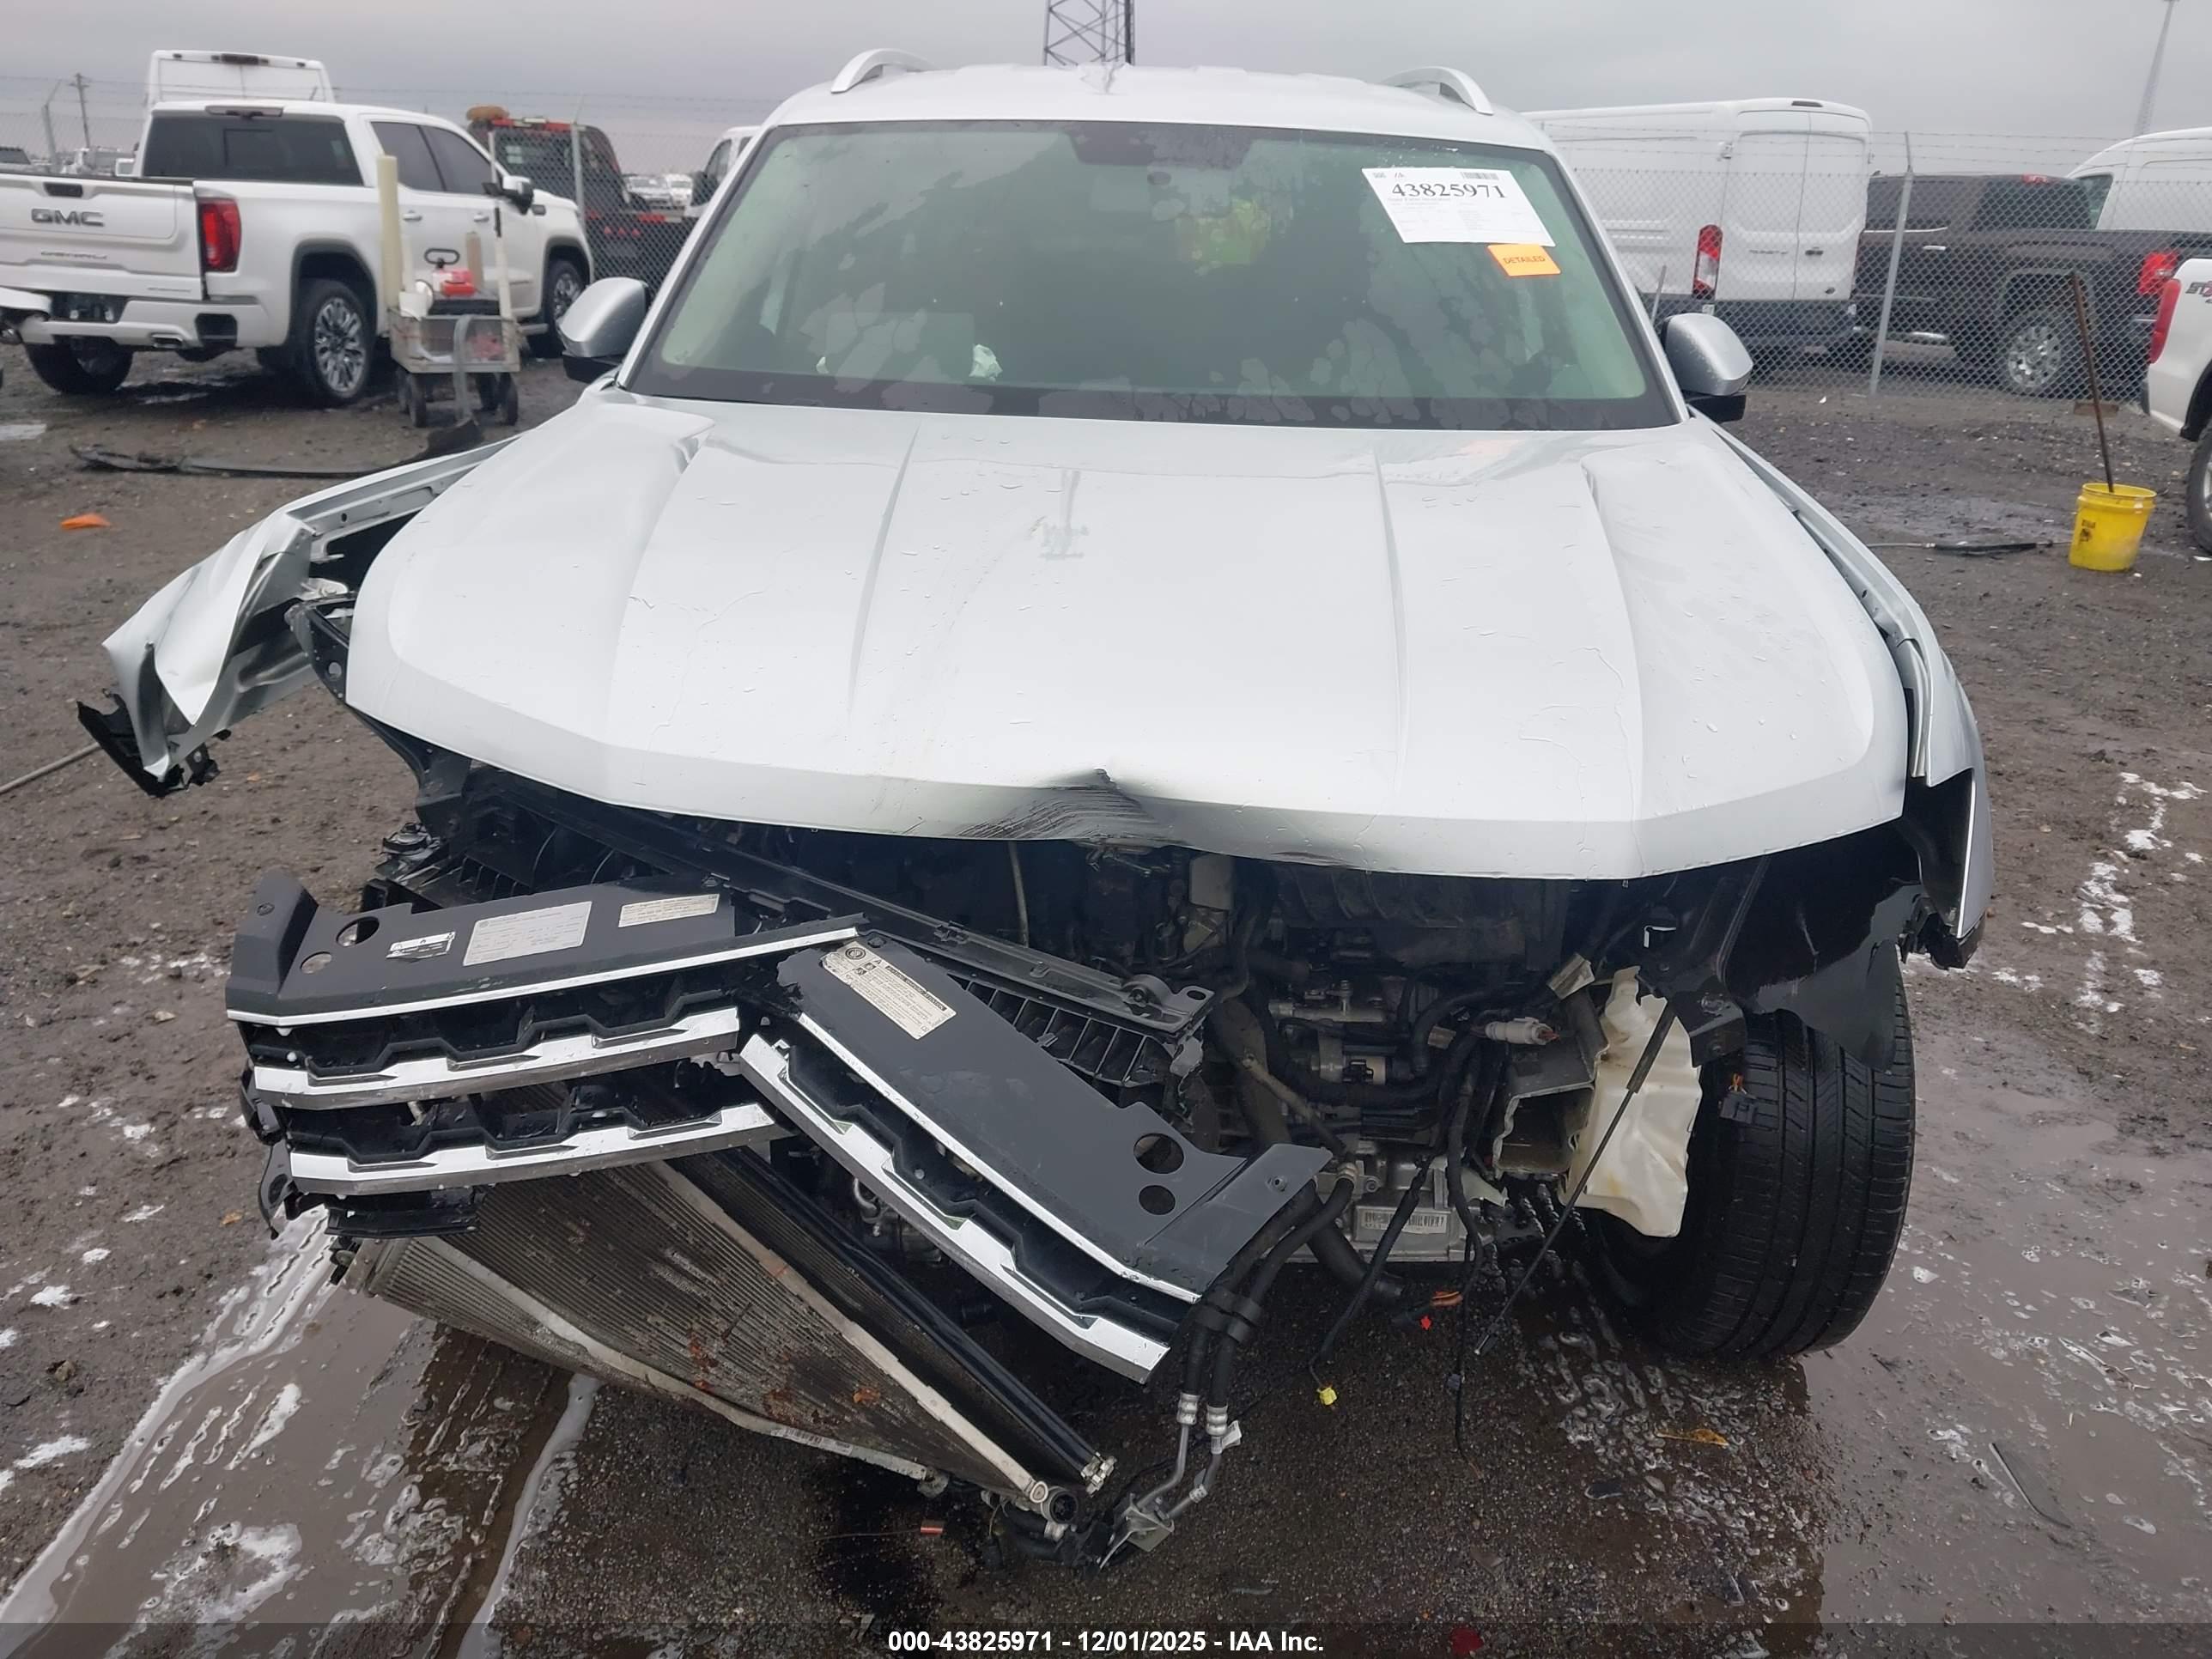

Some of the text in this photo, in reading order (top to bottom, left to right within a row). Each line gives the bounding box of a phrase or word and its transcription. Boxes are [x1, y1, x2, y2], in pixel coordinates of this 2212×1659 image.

[1392, 183, 1507, 198] 43825971
[31, 208, 105, 227] GMC
[1503, 255, 1546, 264] DETAILED
